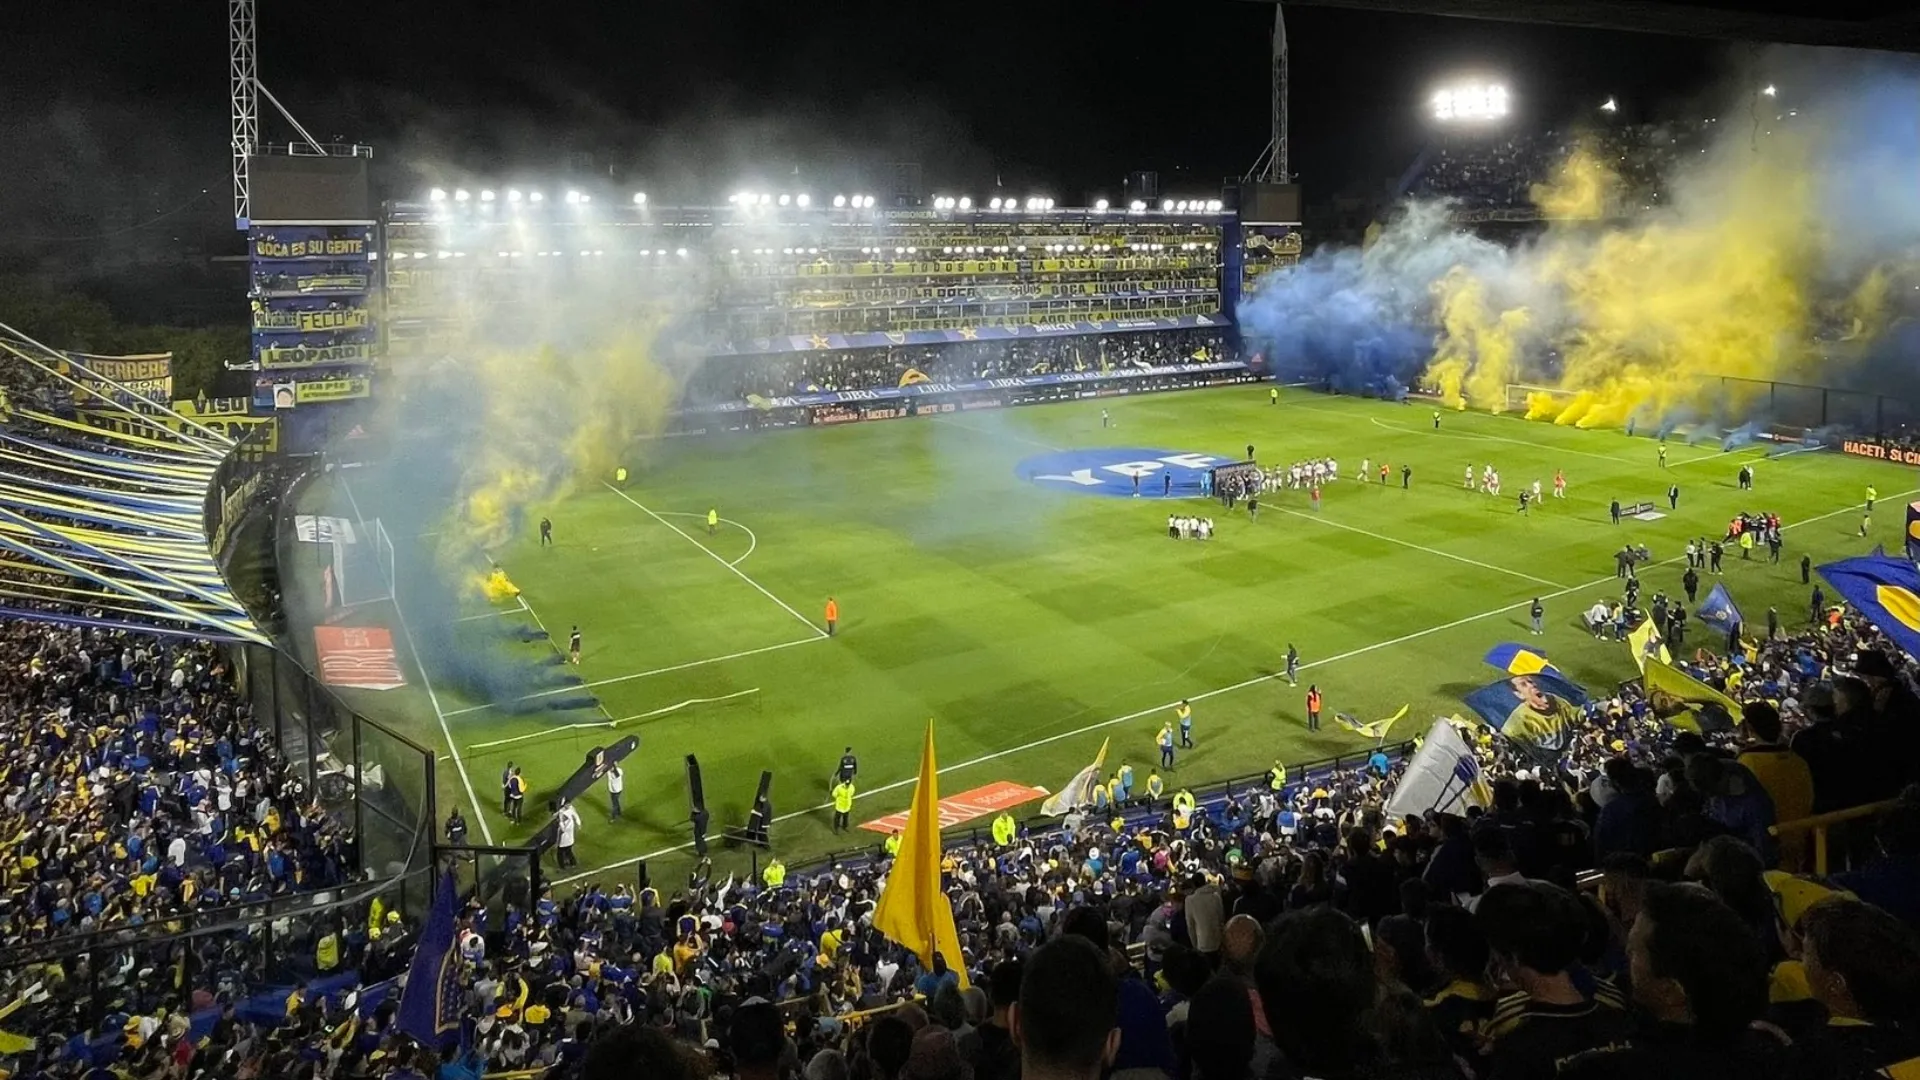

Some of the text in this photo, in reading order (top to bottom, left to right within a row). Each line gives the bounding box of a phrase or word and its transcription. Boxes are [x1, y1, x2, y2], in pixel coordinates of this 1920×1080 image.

[885, 211, 937, 219] BOMBONERA
[257, 239, 363, 257] BOCA ES SU GENTE
[910, 263, 964, 274] TODOS
[267, 346, 362, 363] LEOPARDI
[918, 382, 956, 394] LIBRA
[836, 390, 879, 402] LIBRA
[1033, 453, 1217, 486] YPF
